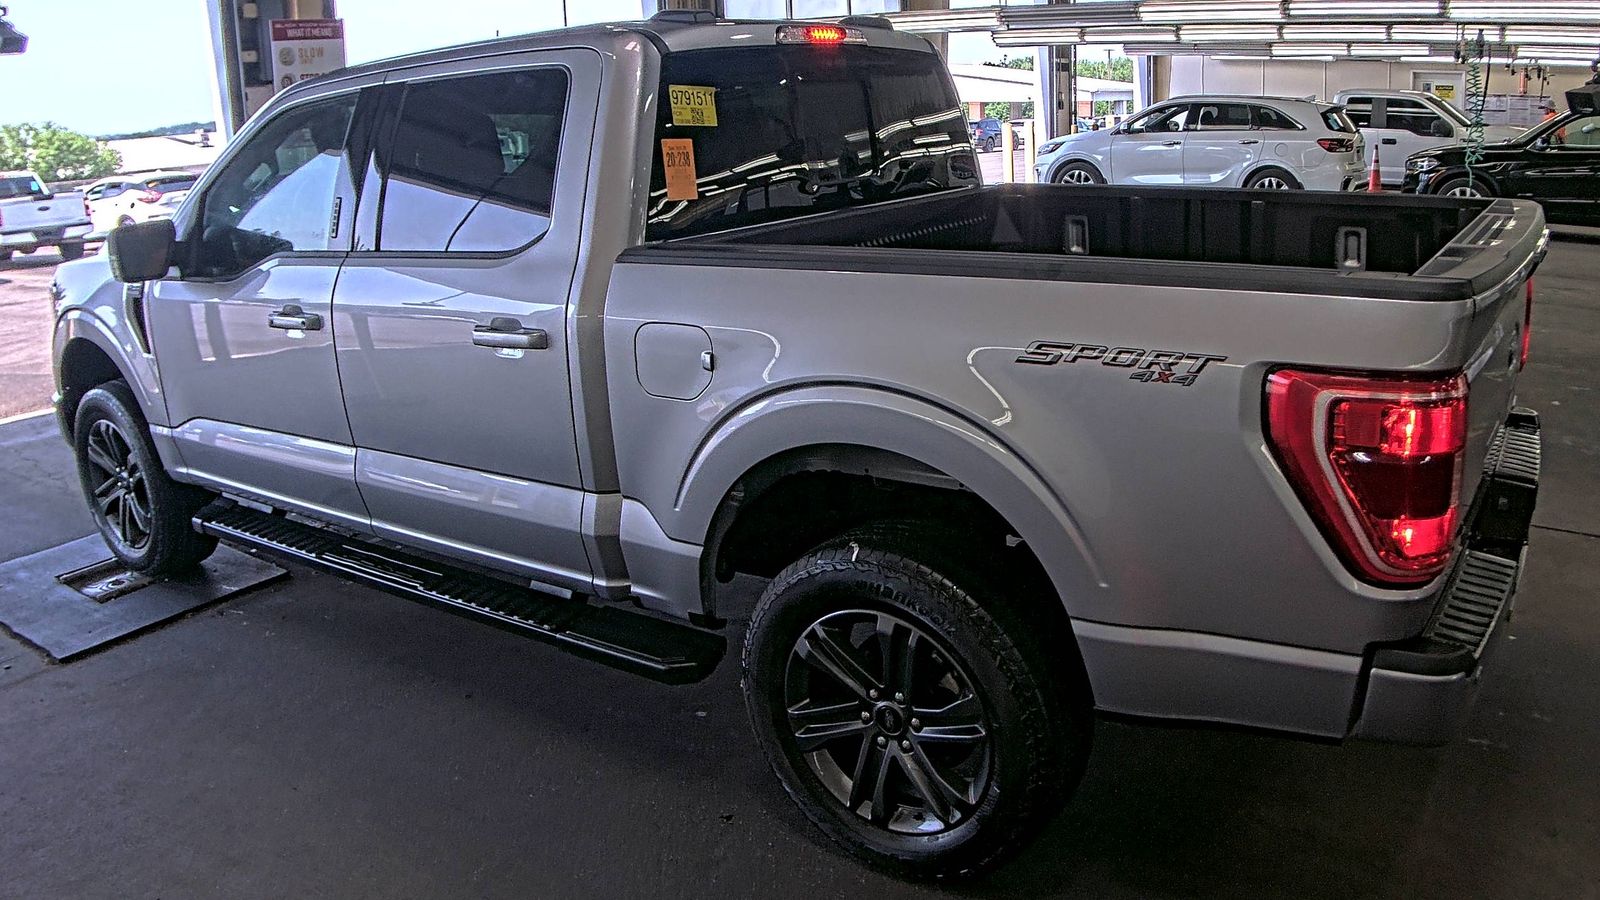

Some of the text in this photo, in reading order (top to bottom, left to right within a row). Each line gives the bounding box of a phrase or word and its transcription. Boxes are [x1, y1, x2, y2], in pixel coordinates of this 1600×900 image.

[298, 47, 324, 58] SLOW
[671, 89, 714, 106] 9791511
[1015, 340, 1228, 373] SPORT
